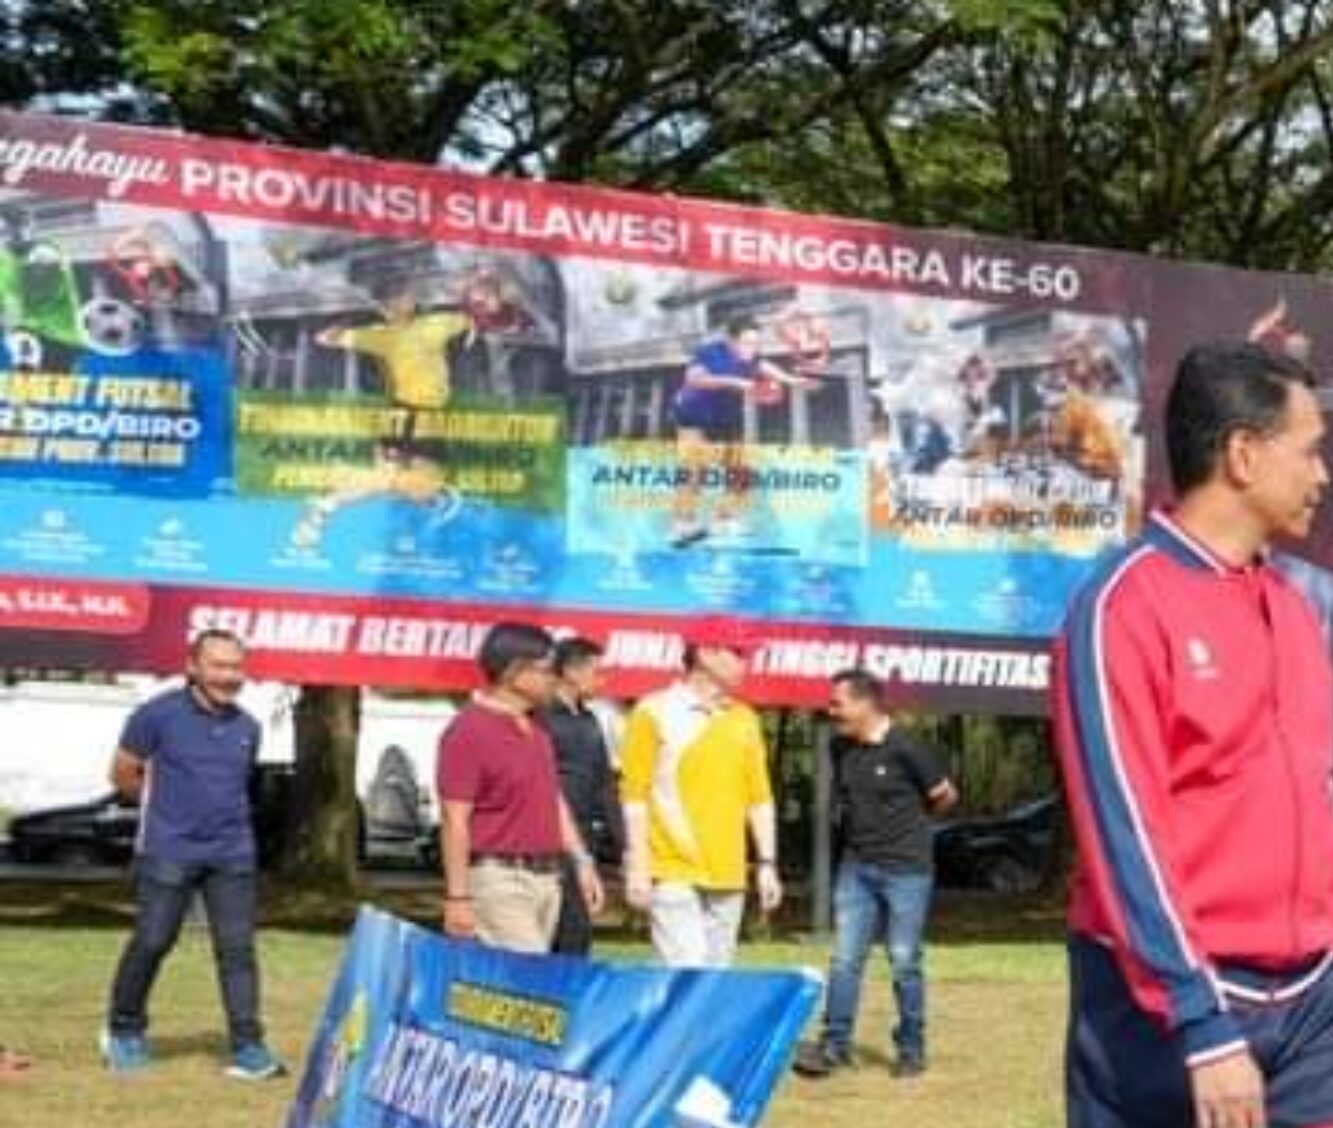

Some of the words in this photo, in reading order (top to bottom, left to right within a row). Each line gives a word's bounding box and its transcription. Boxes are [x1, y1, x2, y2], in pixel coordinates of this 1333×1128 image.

[181, 159, 431, 222] PROVINSI
[444, 196, 689, 255] SULAWESI
[705, 225, 949, 286] TENGGARA
[961, 254, 1081, 300] KE-60
[187, 604, 356, 654] SELAMAT
[862, 643, 1052, 690] SPORTIFITAS
